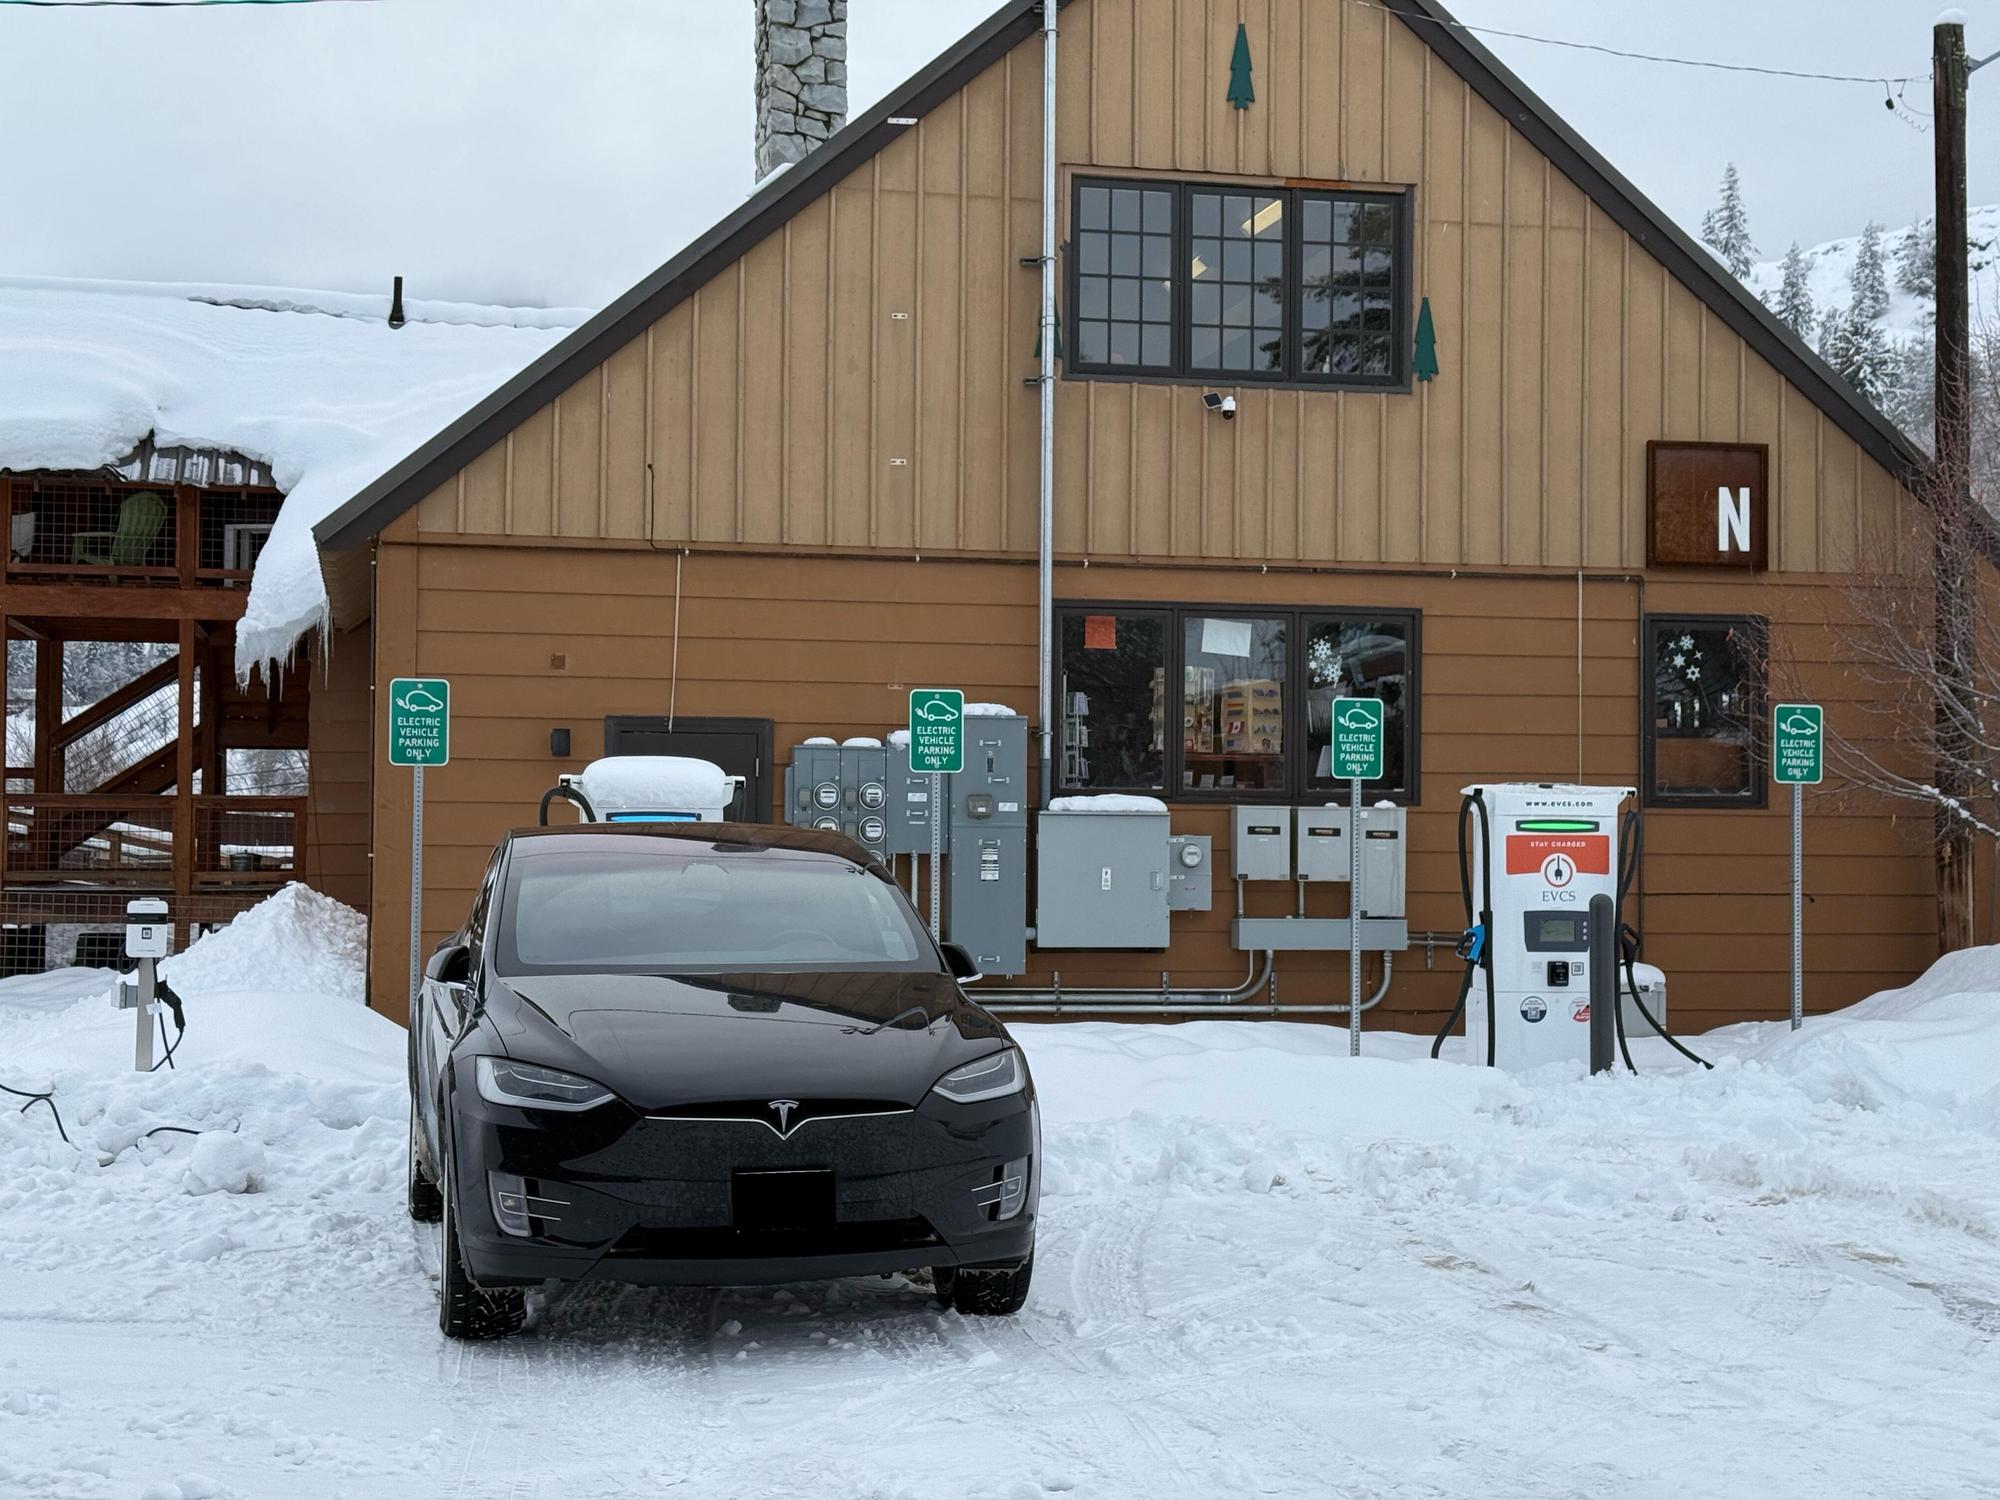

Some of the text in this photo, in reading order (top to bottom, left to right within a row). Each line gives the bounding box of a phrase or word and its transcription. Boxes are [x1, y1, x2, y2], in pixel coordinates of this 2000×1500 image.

[1718, 486, 1751, 552] N
[397, 717, 441, 726] ELECTRIC
[400, 728, 439, 736] VEHICLE
[916, 726, 956, 735] ELECTRIC
[919, 736, 955, 745] VEHICLE
[1338, 734, 1376, 742] ELECTRIC
[399, 739, 440, 747] PARKING
[1780, 739, 1816, 748] ELECTRIC
[918, 746, 956, 755] PARKING
[1341, 744, 1374, 752] VEHICLE
[406, 749, 432, 758] ONLY
[1340, 753, 1375, 762] PARKING
[1782, 748, 1814, 758] VEHICLE
[924, 756, 948, 765] ONLY
[1782, 758, 1814, 767] PARKING
[1346, 763, 1368, 772] ONLY
[1788, 768, 1809, 776] ONLY
[1542, 891, 1576, 902] EVCS
